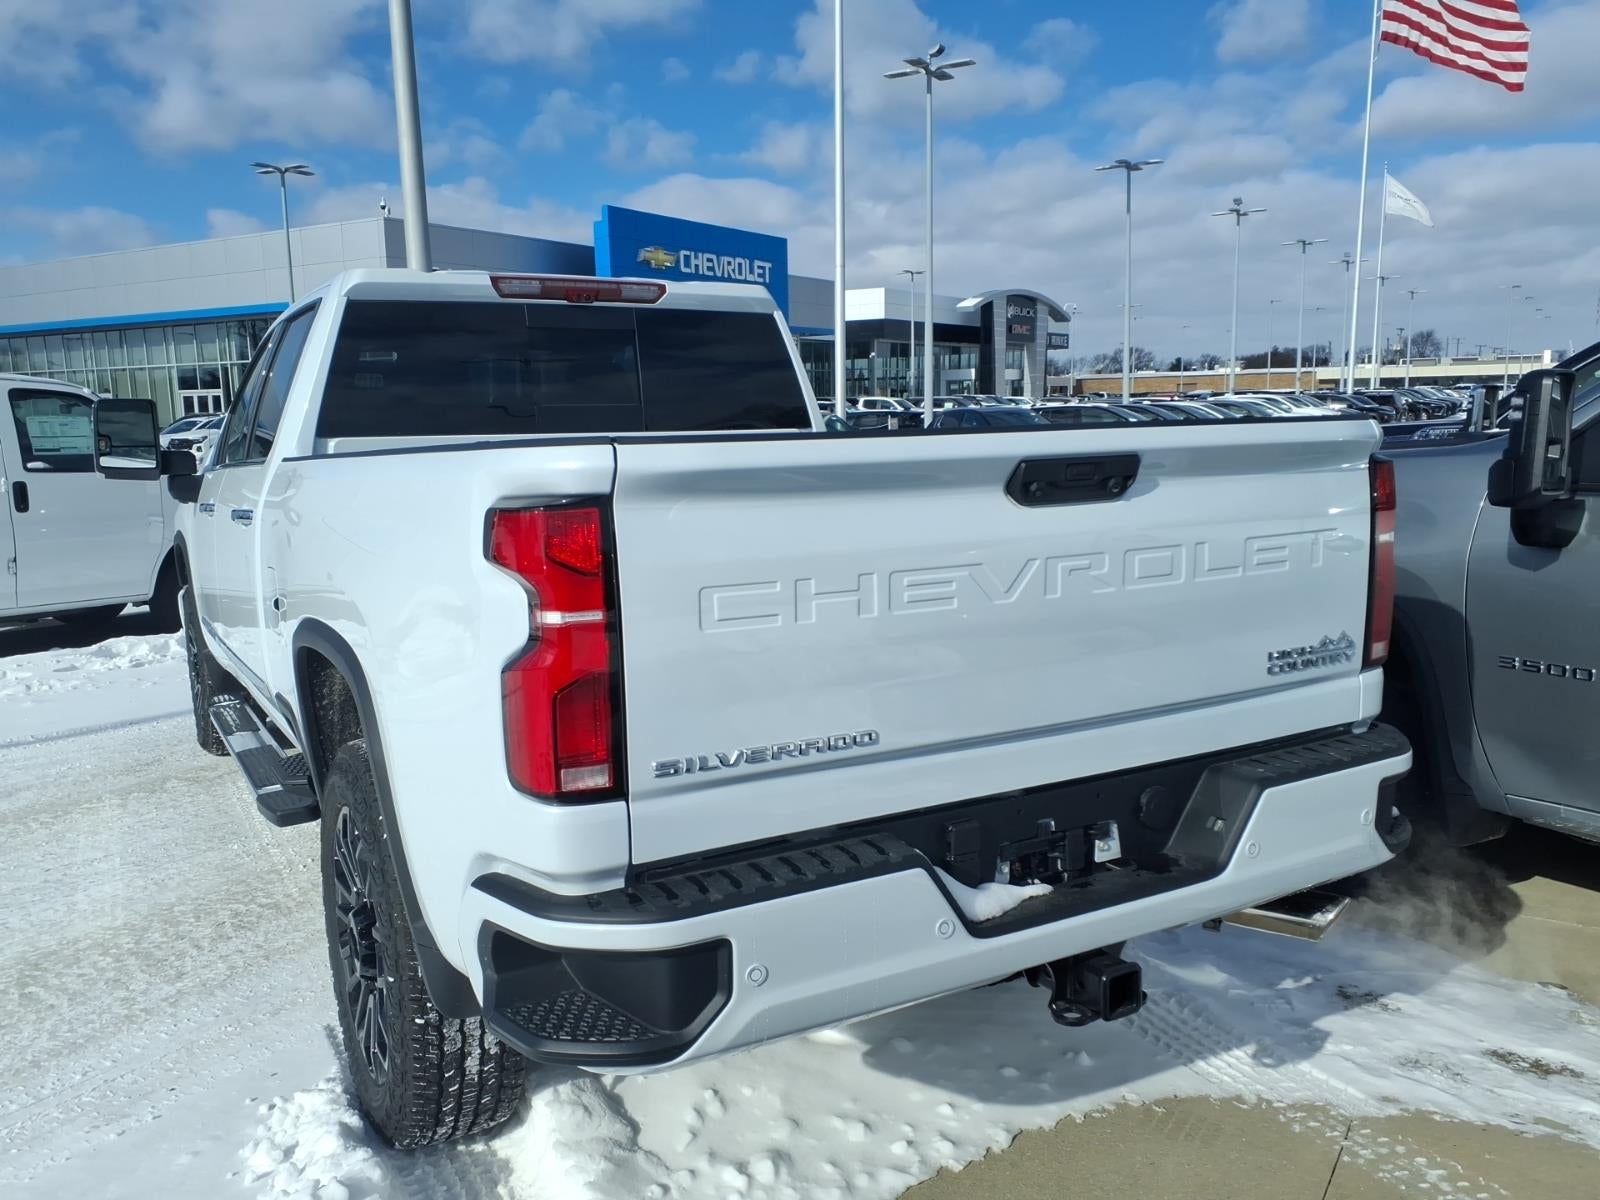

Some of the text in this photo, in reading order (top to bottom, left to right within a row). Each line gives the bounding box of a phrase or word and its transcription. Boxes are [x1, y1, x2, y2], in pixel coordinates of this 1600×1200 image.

[680, 250, 772, 283] CHEVROLET
[1014, 306, 1035, 317] BUICK
[699, 528, 1338, 633] CHEVROLET
[1267, 645, 1314, 662] HIGH
[1267, 649, 1354, 676] COUNTRY
[1498, 655, 1597, 682] 3500
[651, 729, 880, 778] SILVERADO
